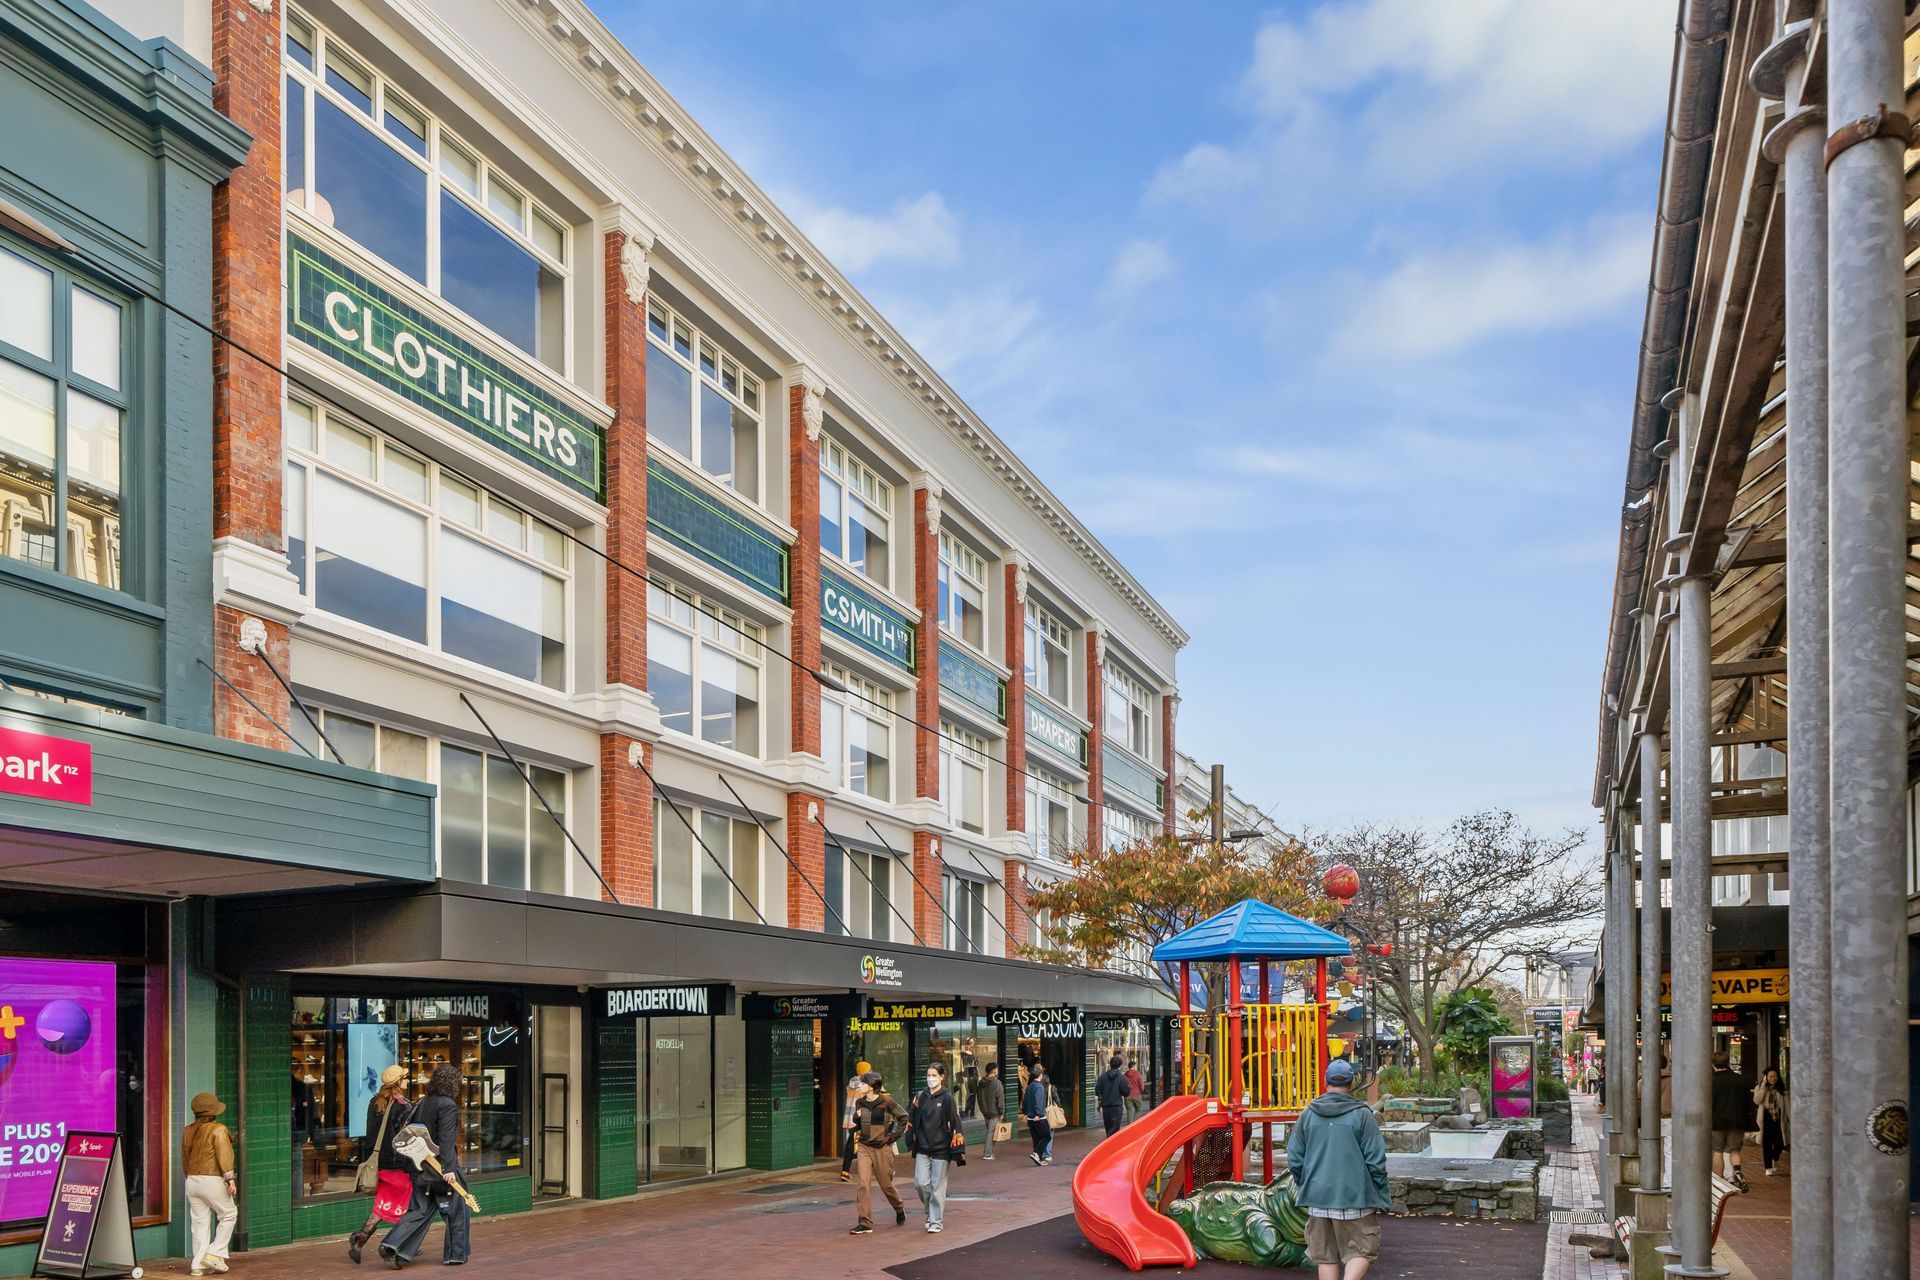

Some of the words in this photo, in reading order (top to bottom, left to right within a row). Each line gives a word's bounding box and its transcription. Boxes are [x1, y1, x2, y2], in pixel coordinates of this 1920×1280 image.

[325, 291, 577, 467] CLOTHIERS
[897, 628, 908, 643] LTD
[1031, 711, 1076, 754] DRAPERS
[875, 955, 895, 967] Greater
[875, 966, 902, 980] Wellington
[607, 987, 708, 1018] BOARDERTOWN
[792, 1004, 829, 1013] Wellington
[891, 1004, 954, 1018] Martens
[992, 1008, 1071, 1024] GLASSONS
[4, 1122, 51, 1141] PLUS
[13, 1170, 36, 1178] MOBILE
[61, 1184, 99, 1196] EXPERIENCE
